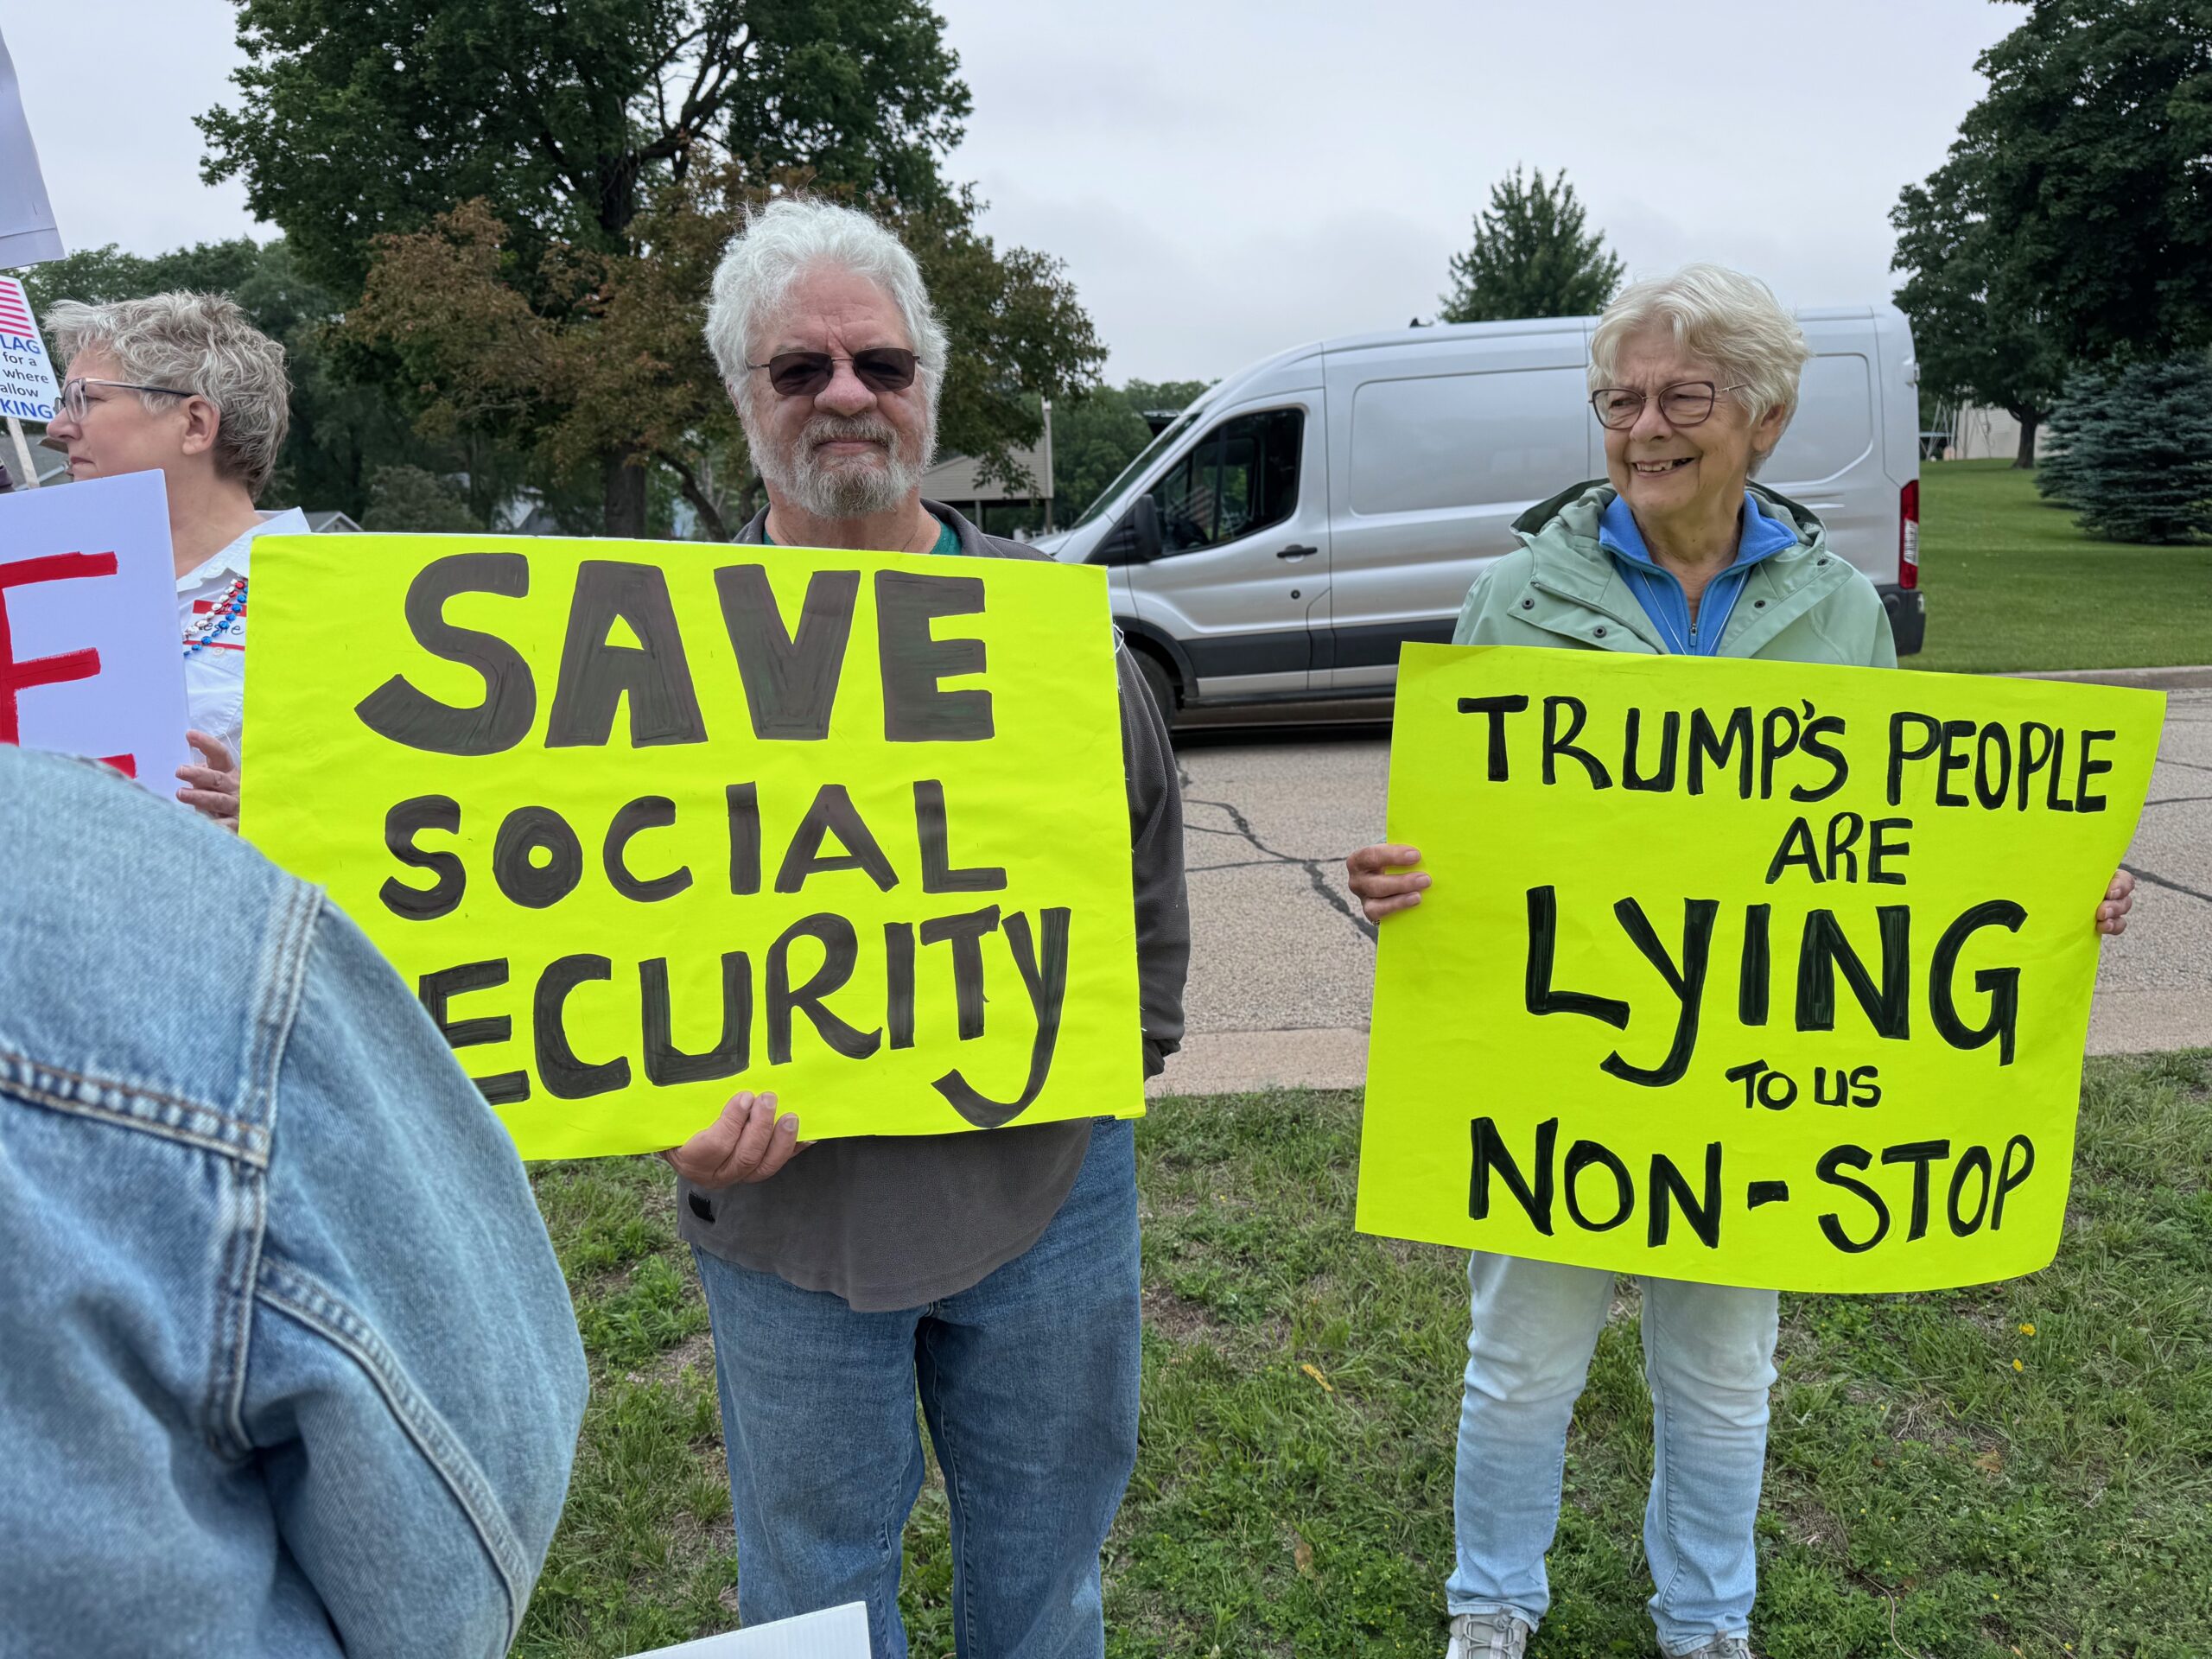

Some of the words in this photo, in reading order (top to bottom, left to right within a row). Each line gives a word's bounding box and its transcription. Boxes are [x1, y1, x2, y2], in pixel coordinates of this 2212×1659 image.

[0, 334, 41, 354] LAG
[3, 351, 23, 365] for
[29, 358, 37, 366] a
[0, 383, 39, 398] allow
[0, 398, 53, 419] KING
[3, 368, 49, 385] where
[353, 552, 995, 758] SAVE
[1457, 694, 1849, 803] TRUMP'S
[1886, 710, 2117, 814] PEOPLE
[378, 779, 1007, 921] SOCIAL
[1764, 811, 1913, 886] ARE
[419, 904, 1072, 1129] ECURITY
[1725, 1058, 1798, 1111] TO
[1814, 1065, 1882, 1109] US
[1468, 1116, 2035, 1254] NON-STOP
